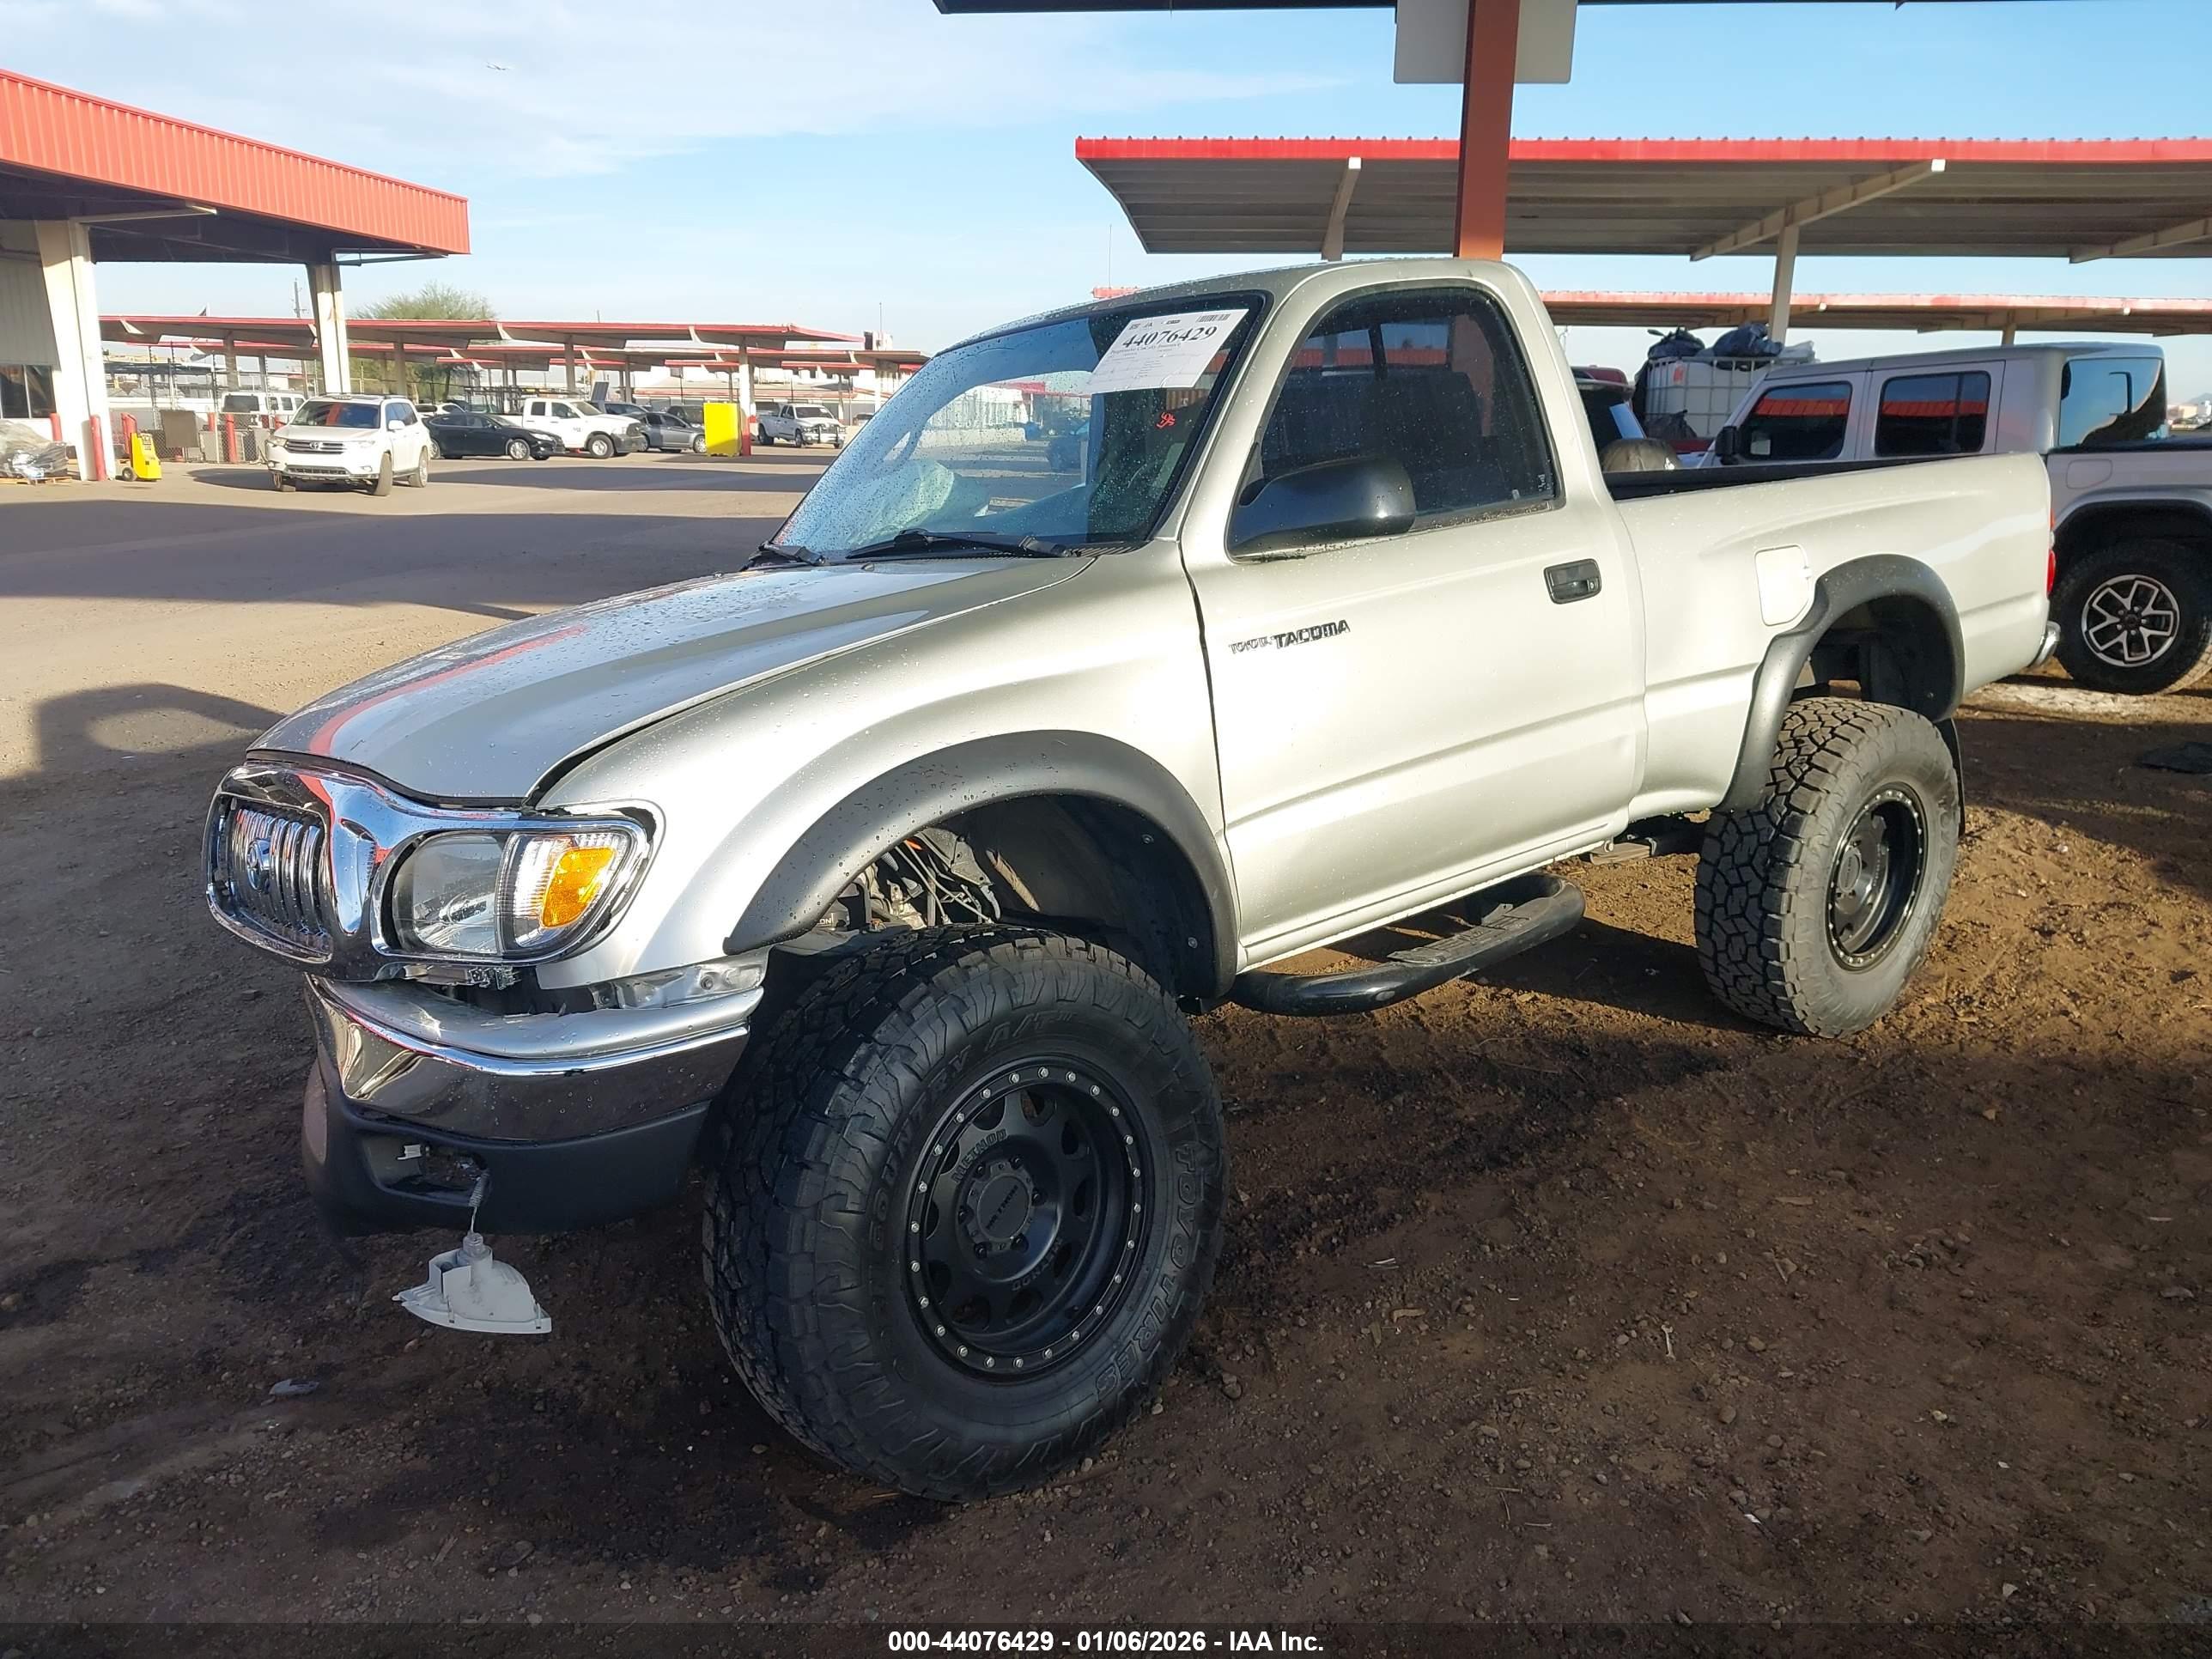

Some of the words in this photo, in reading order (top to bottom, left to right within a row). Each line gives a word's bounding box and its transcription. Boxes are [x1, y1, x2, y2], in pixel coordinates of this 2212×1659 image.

[1123, 325, 1218, 348] 44076429
[1229, 636, 1273, 653] TOYOTA
[1273, 619, 1351, 649] TACOMA
[951, 1128, 1007, 1183] METHOD
[1176, 1143, 1197, 1270] TOYO
[1095, 1273, 1178, 1402] TIRES
